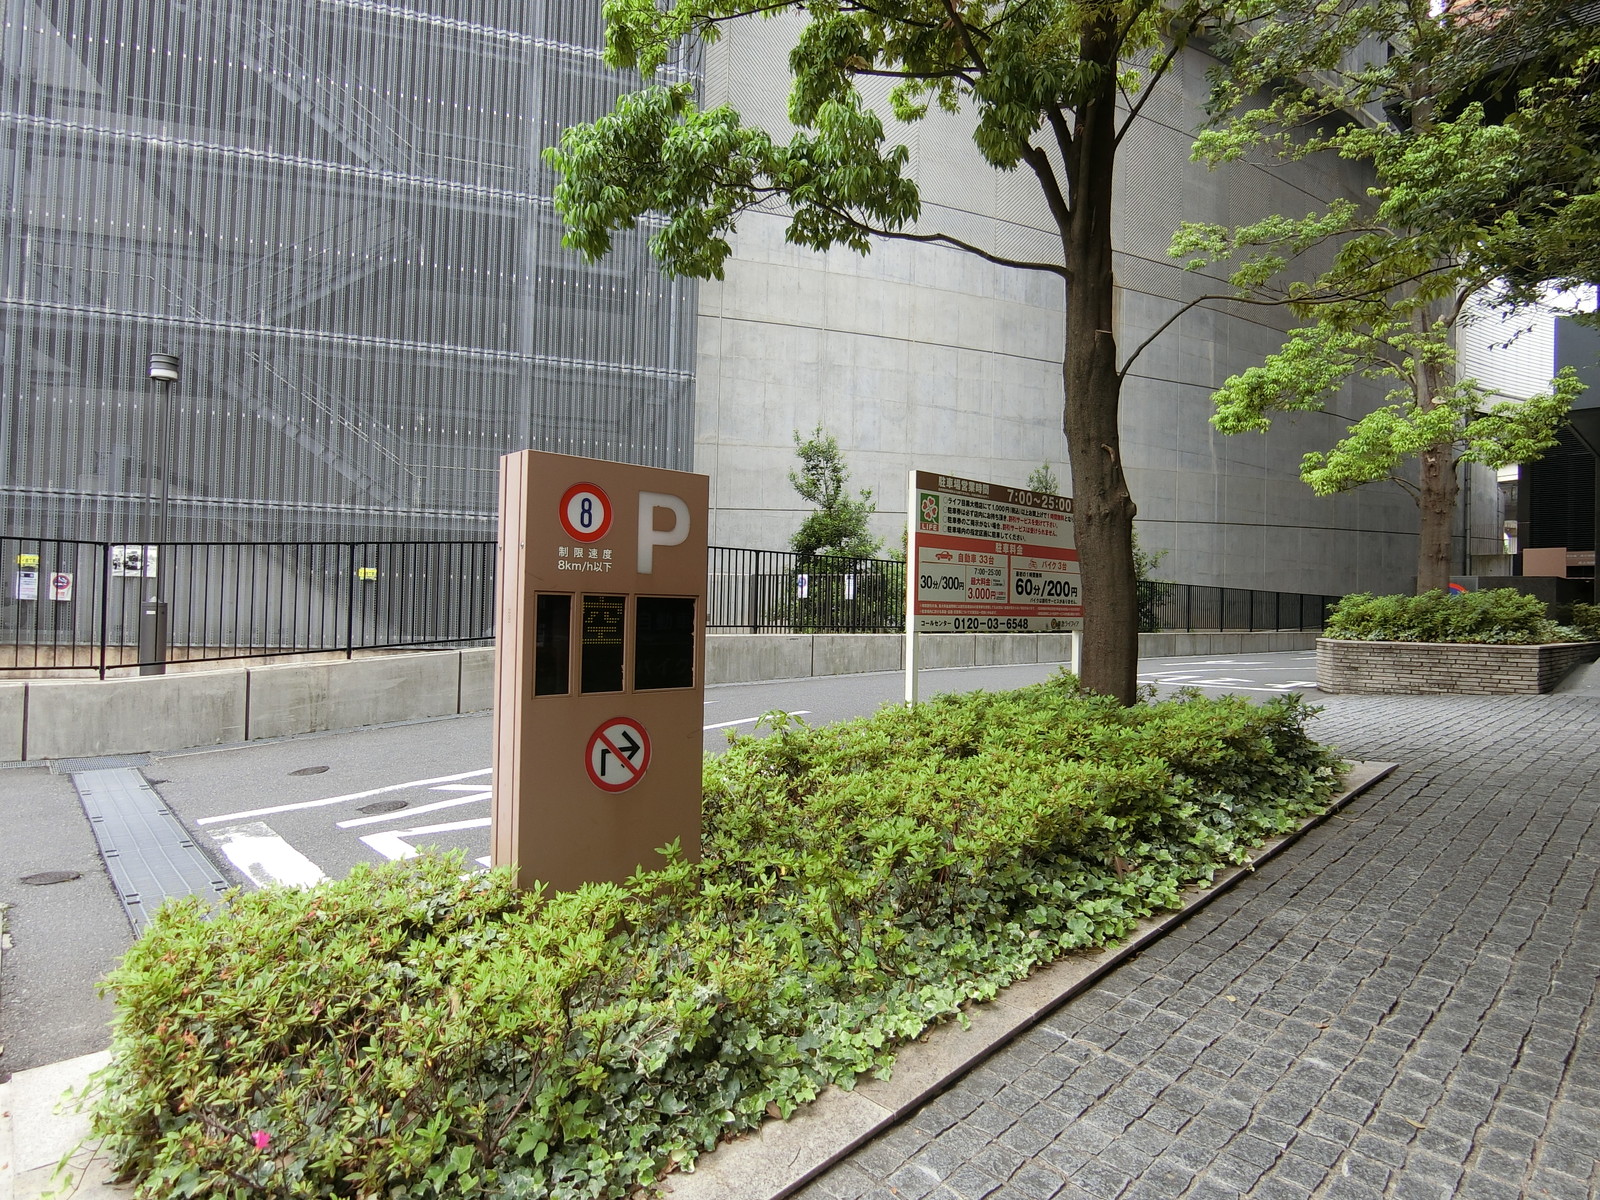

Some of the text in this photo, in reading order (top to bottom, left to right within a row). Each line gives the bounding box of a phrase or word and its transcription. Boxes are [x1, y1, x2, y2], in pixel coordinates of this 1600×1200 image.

[938, 476, 990, 495] 駐車場営業時間
[580, 497, 593, 529] 8
[637, 490, 691, 575] P
[922, 523, 938, 531] LIFE
[558, 547, 612, 560] 制限速度
[996, 542, 1024, 556] 駐車料金
[958, 553, 994, 566] 自動車 33台
[1042, 561, 1067, 571] バイク 3台
[557, 560, 612, 573] 8km/h以下
[920, 574, 965, 591] 30分/300円
[1015, 578, 1078, 598] 60分/200円
[954, 617, 1029, 630] 0120-03-6548
